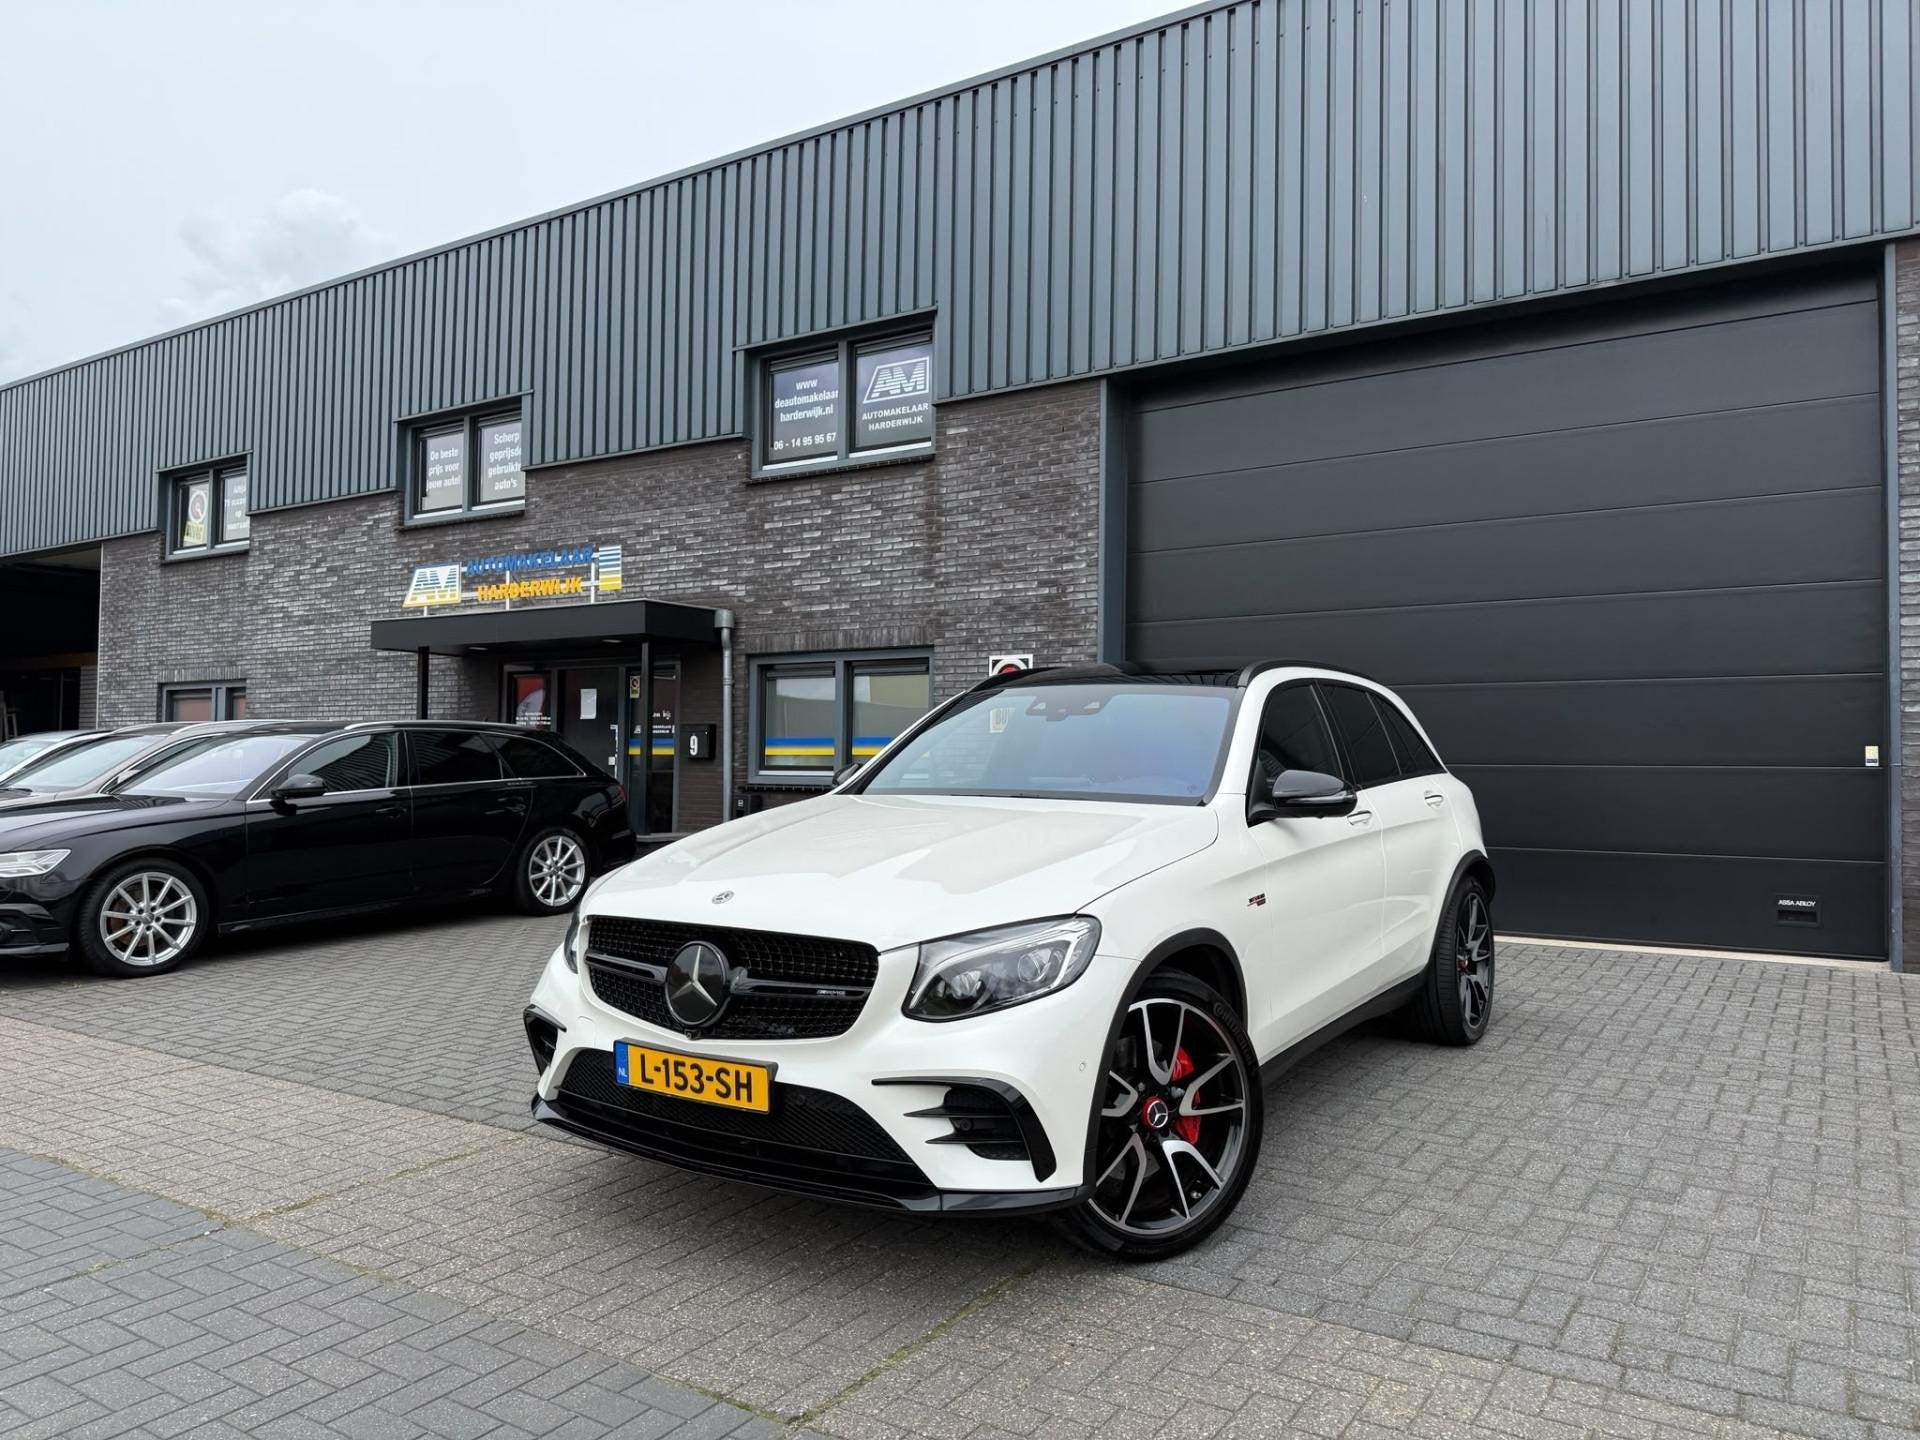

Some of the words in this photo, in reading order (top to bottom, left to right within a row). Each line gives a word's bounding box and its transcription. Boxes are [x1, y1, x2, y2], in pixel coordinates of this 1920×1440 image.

[796, 379, 818, 391] www
[780, 404, 833, 422] harderwijk.nl
[862, 403, 928, 420] AUTOMAKELAAR
[868, 415, 923, 431] HARDERWIJK
[494, 432, 519, 445] Scherp
[774, 440, 784, 450] 06
[791, 438, 800, 448] 14
[802, 436, 812, 446] 95
[814, 434, 824, 444] 95
[827, 432, 836, 442] 67
[430, 451, 439, 461] De
[440, 448, 458, 460] beste
[429, 464, 443, 477] prijs
[445, 463, 459, 472] voor
[494, 478, 518, 490] auto's
[466, 547, 593, 576] AUTOMAKELAAR
[476, 576, 584, 602] HARDERWIJK
[690, 735, 698, 755] 9
[618, 1067, 627, 1077] NL
[640, 1053, 752, 1103] L-153-SH
